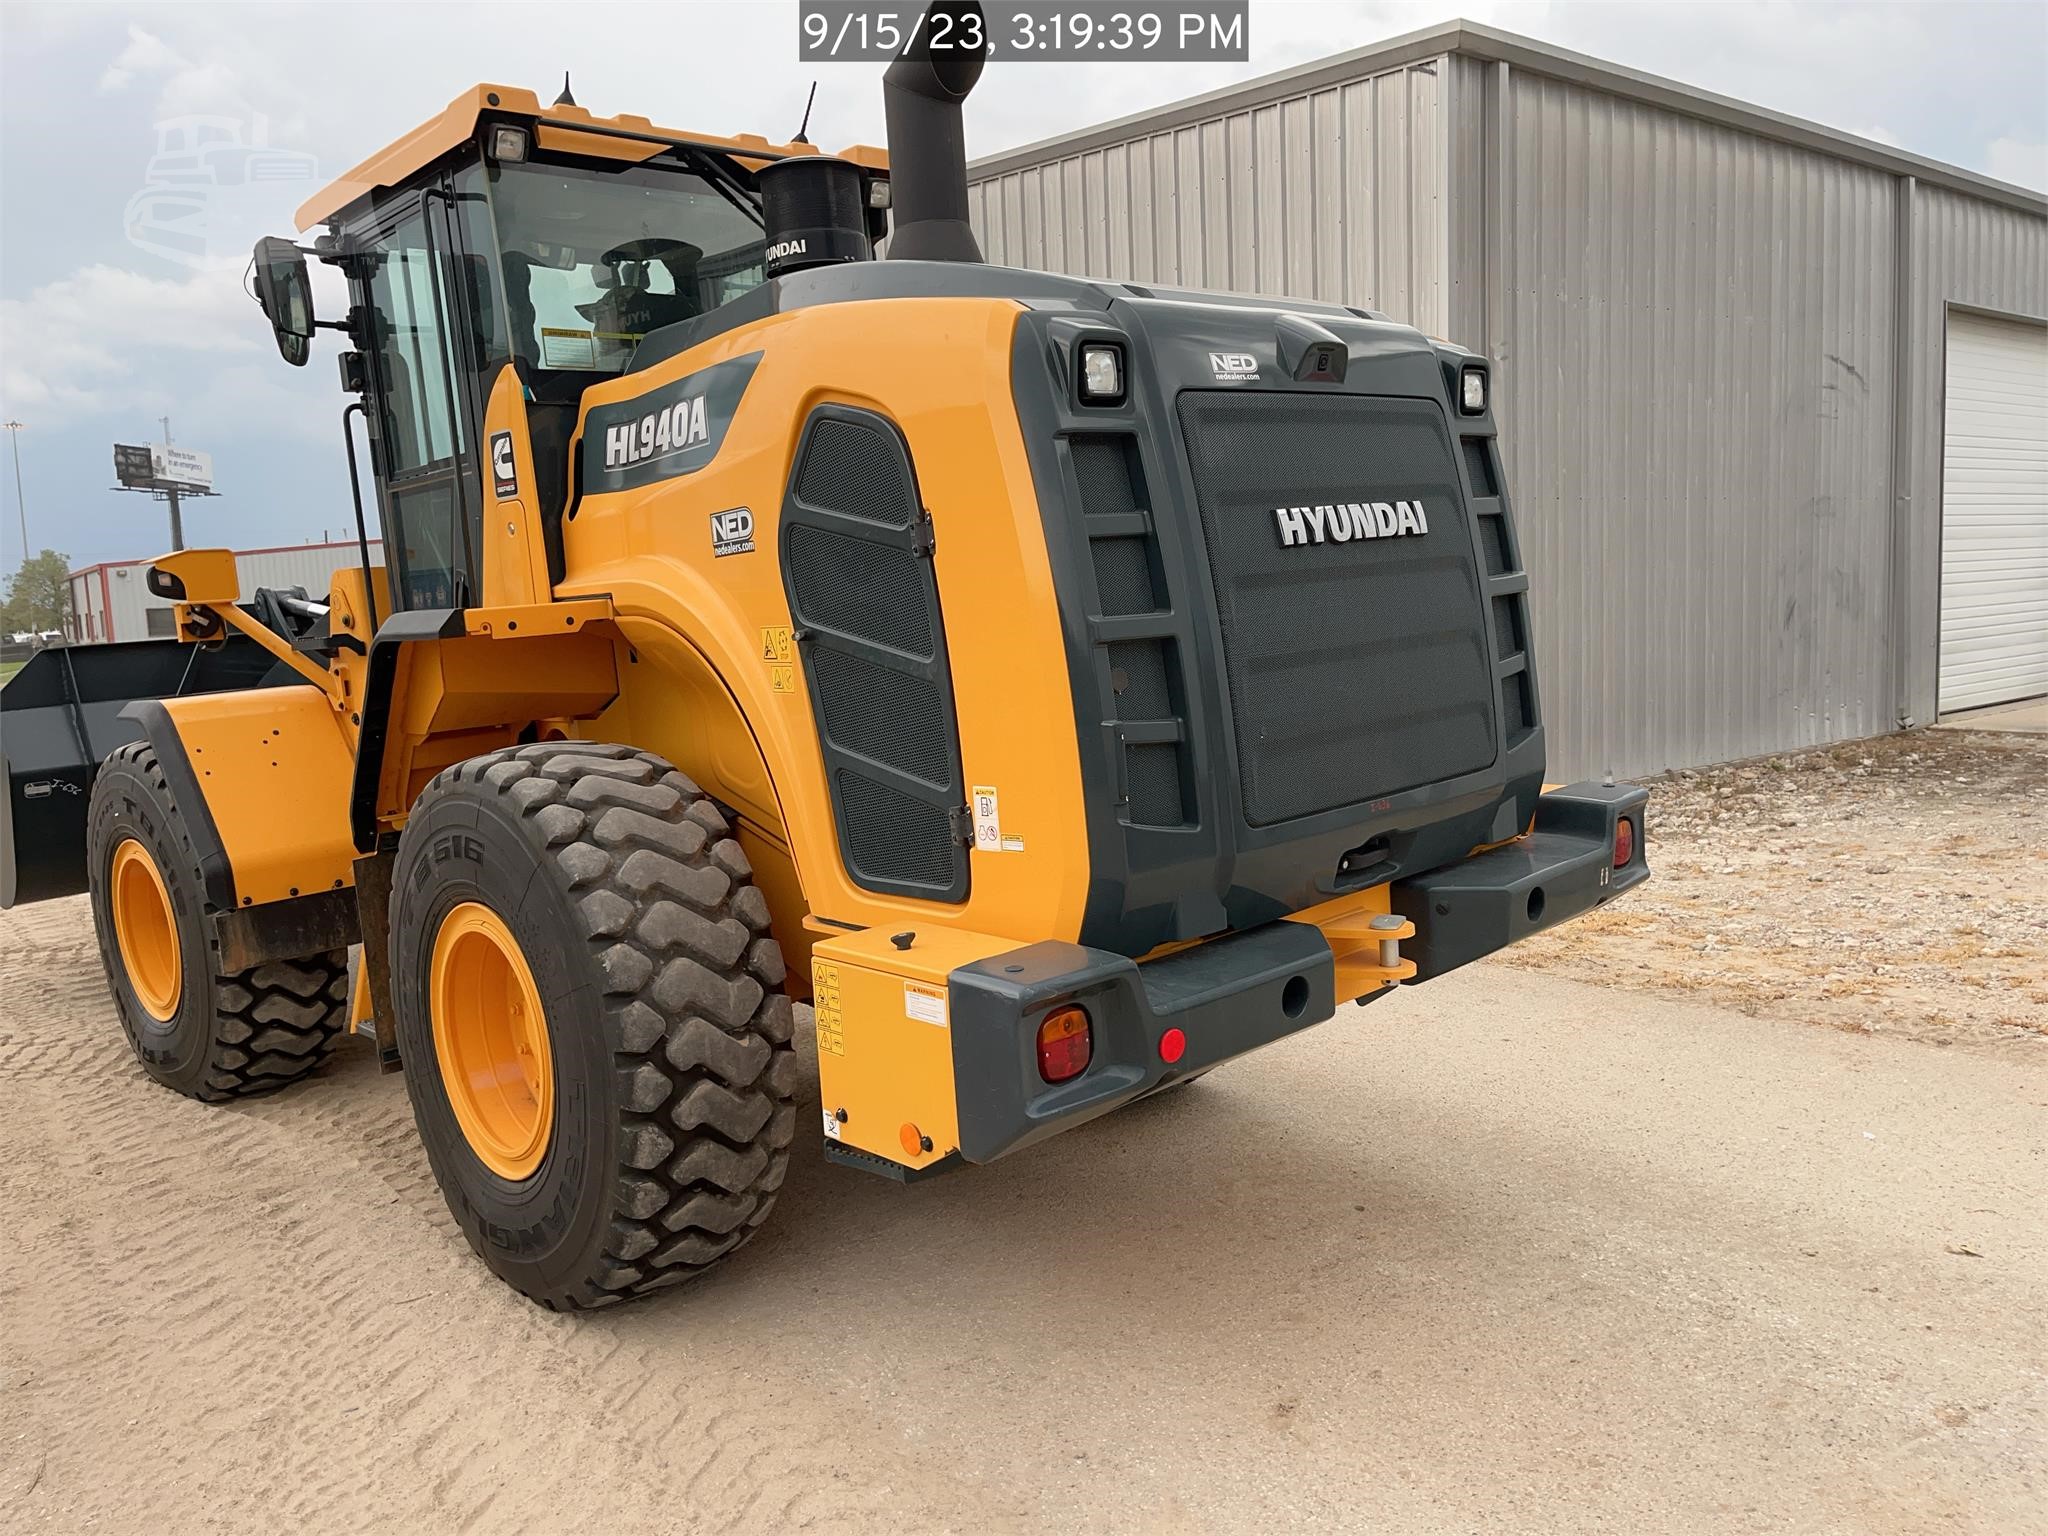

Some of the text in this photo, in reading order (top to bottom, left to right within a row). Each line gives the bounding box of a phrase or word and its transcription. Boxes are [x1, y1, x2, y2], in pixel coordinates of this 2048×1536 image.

[765, 239, 806, 264] UNDAI
[1209, 353, 1258, 373] NED
[1215, 372, 1260, 380] nedealers.com
[606, 395, 707, 466] HL940A
[711, 509, 753, 543] NED
[1274, 500, 1429, 546] HYUNDAI
[714, 541, 755, 556] nedealers.com
[917, 988, 937, 998] WARNING
